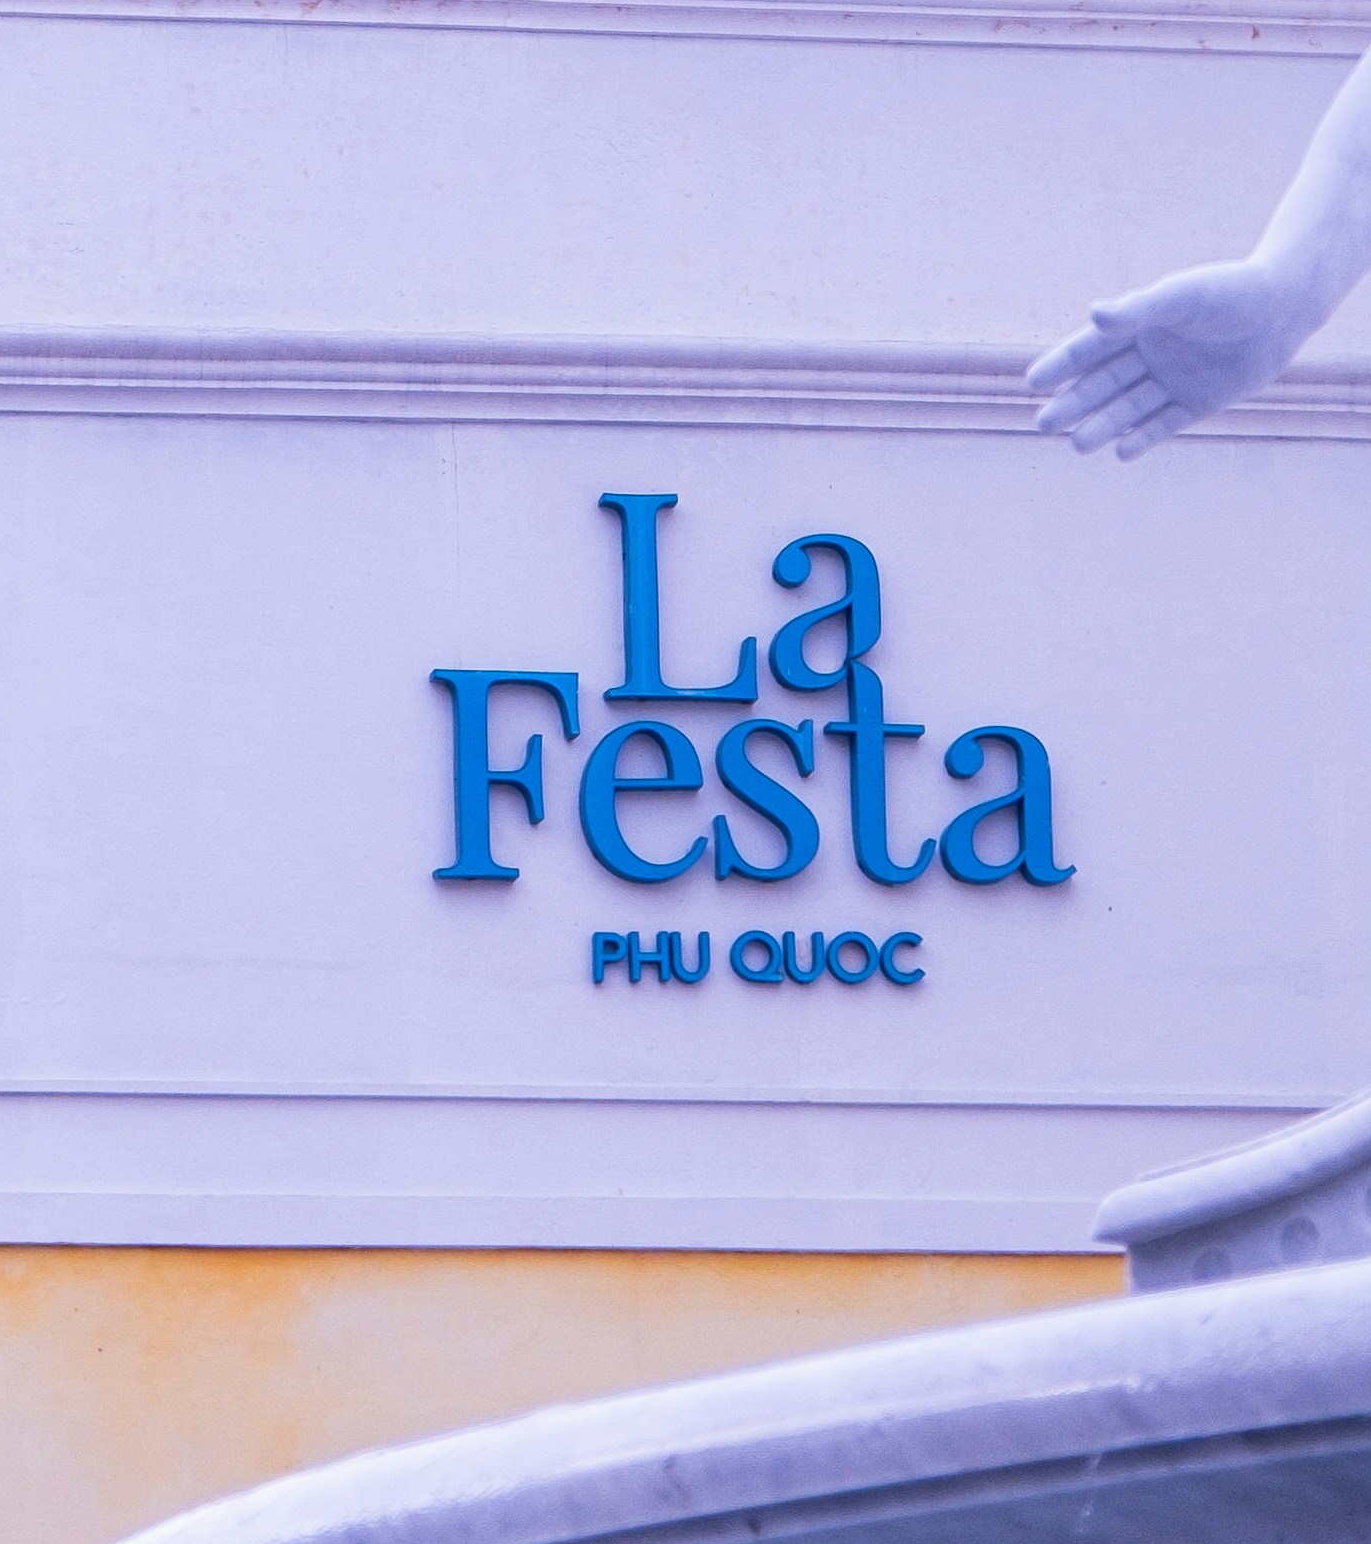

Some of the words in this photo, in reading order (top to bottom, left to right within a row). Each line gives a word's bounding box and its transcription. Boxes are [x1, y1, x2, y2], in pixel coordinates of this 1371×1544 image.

[598, 492, 882, 703] La
[429, 659, 1078, 886] Festa
[591, 930, 711, 984] PHU
[729, 929, 926, 984] QUOC
